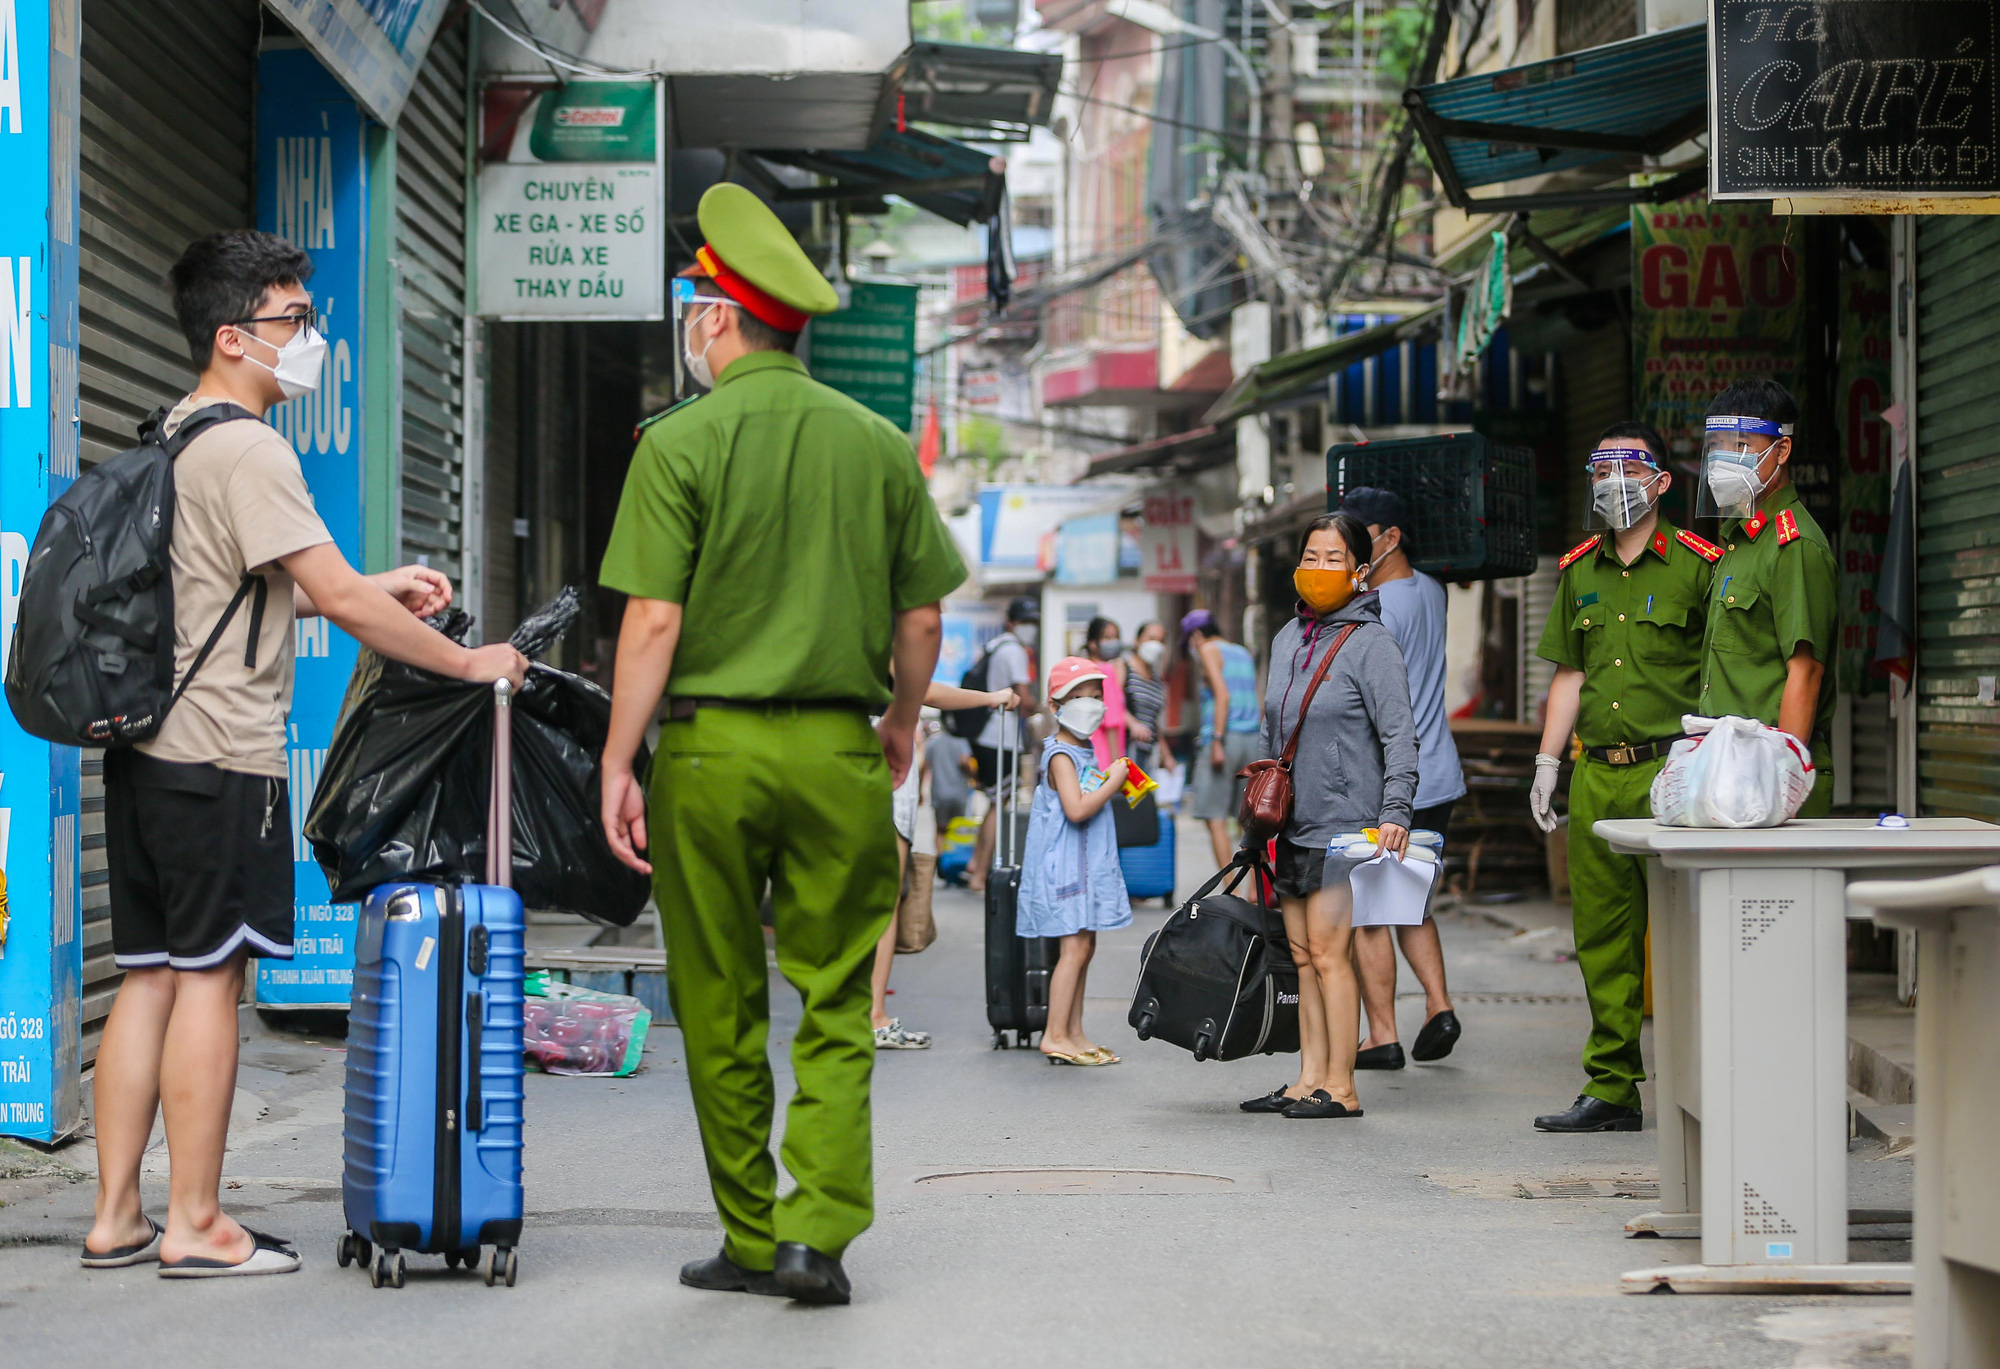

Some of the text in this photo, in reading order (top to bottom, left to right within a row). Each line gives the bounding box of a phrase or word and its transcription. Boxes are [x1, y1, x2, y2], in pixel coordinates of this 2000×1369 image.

[1733, 37, 1985, 131] CAFÉ
[1737, 146, 1798, 177] SINH
[1805, 137, 1842, 177] TỐ
[1866, 137, 1947, 177] NƯỚC
[1956, 135, 1989, 176] ÉP
[276, 111, 335, 249] NHÀ
[524, 177, 614, 201] CHUYÊN
[494, 214, 521, 233] XE
[529, 214, 560, 233] GA
[580, 214, 607, 233] XE
[615, 207, 645, 233] SỐ
[529, 239, 609, 266] RỬA XE
[514, 279, 571, 298] THAY
[1642, 244, 1796, 324] GẠO
[300, 906, 306, 922] 1
[335, 905, 354, 922] 328
[319, 933, 344, 955] TRÃI
[271, 969, 300, 985] THANH
[301, 965, 326, 985] XUÂN
[326, 968, 353, 985] TRUNG
[20, 1018, 44, 1040] 328
[1, 1055, 31, 1083] TRÃI
[10, 1102, 44, 1123] TRUNG
